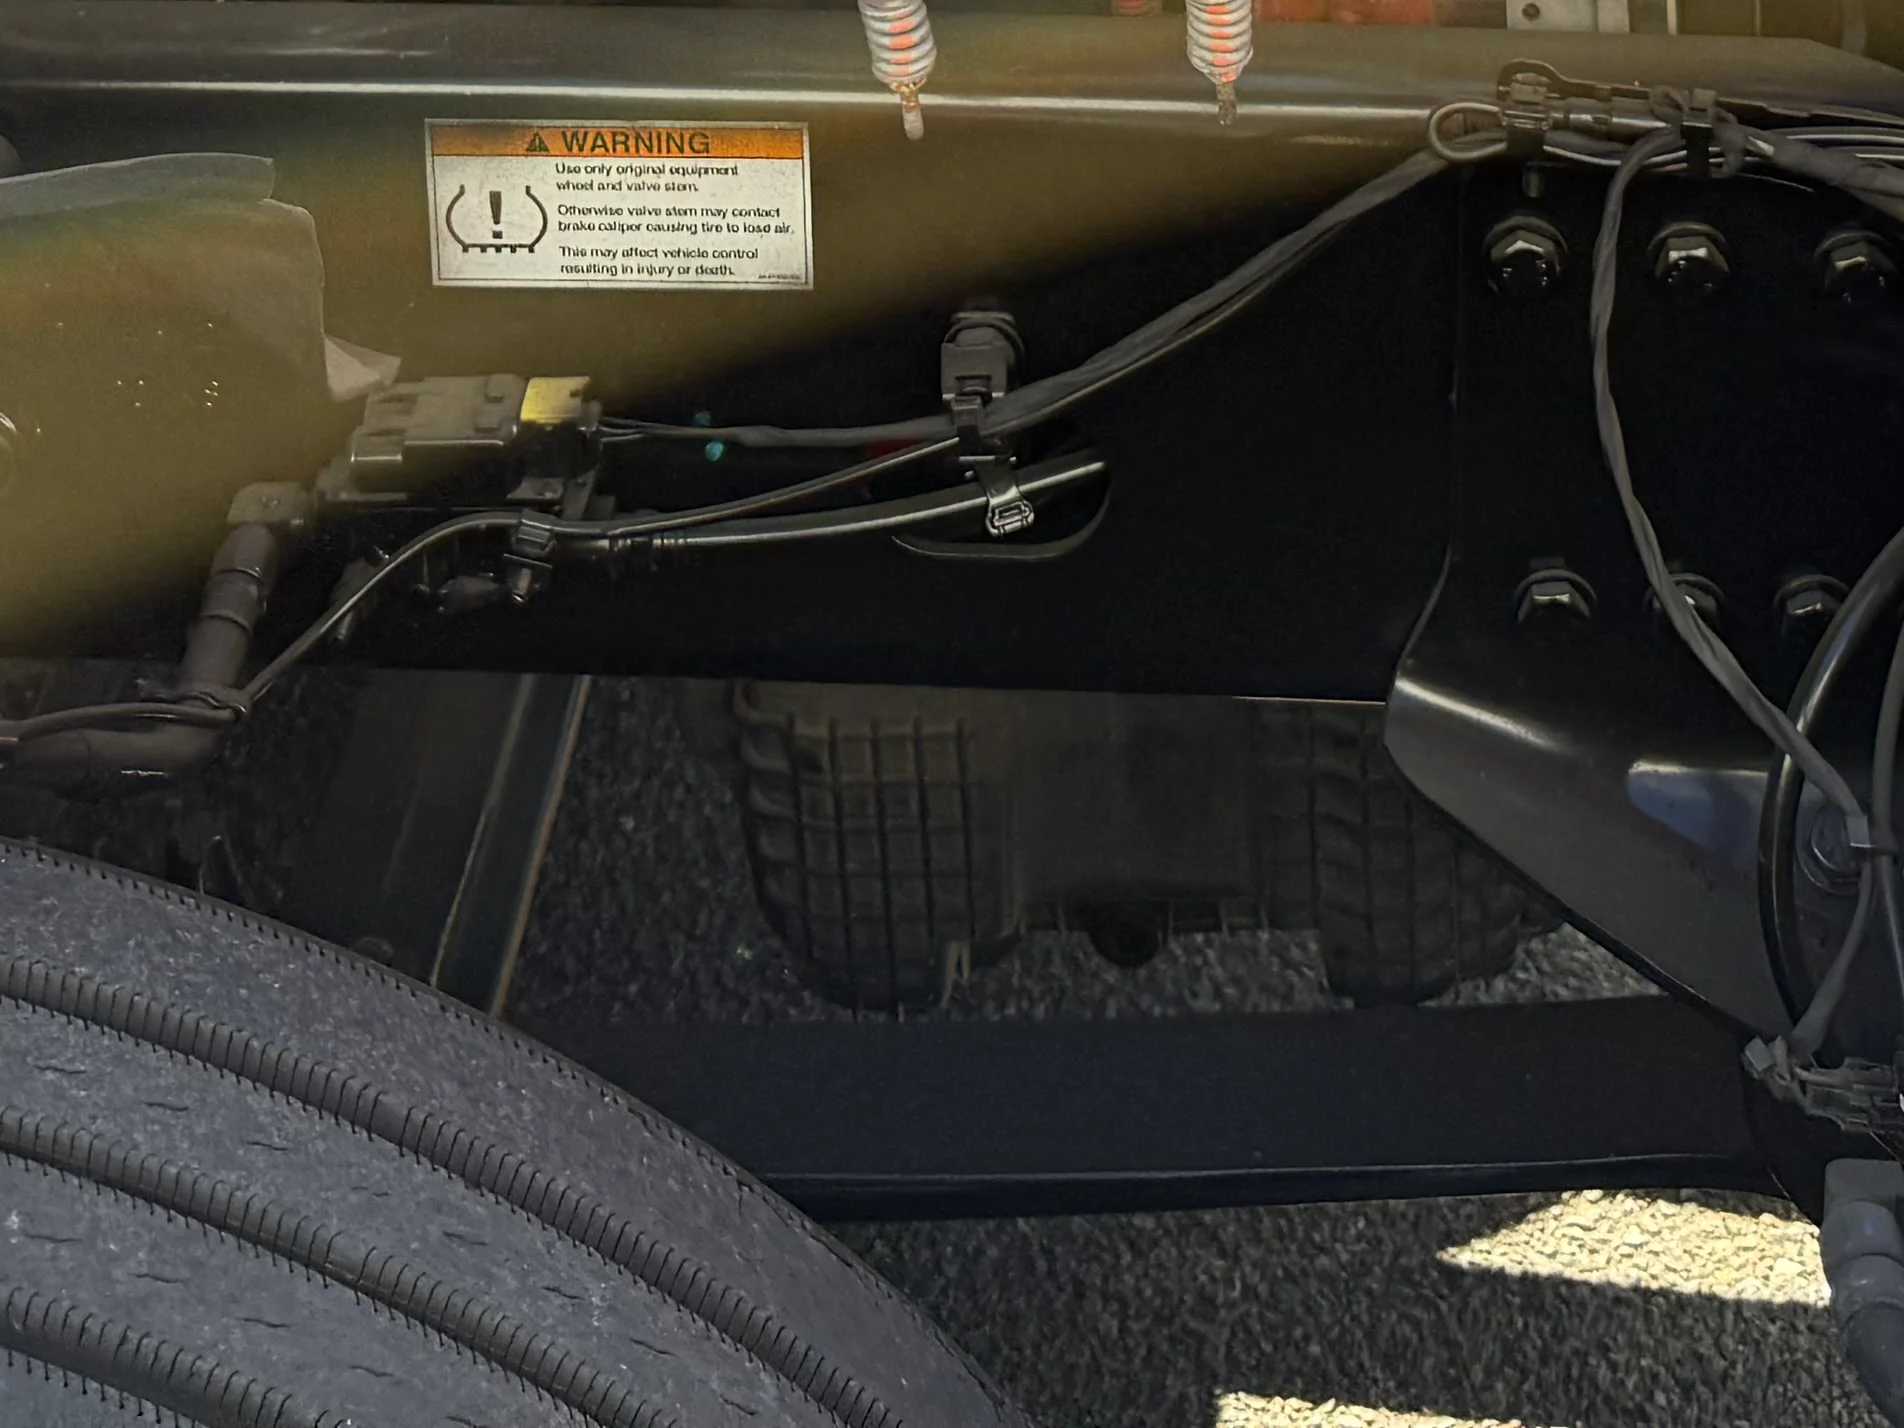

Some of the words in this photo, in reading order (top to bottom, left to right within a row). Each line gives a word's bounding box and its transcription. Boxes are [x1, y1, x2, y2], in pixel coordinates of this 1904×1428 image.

[561, 130, 711, 155] WARNING
[555, 161, 581, 175] Use
[584, 163, 612, 177] only
[615, 163, 666, 177] original
[669, 165, 739, 179] equipment
[556, 180, 594, 191] wheel
[597, 180, 622, 191] and
[626, 180, 661, 191] valve
[664, 181, 699, 192] stem.
[557, 204, 624, 216] Otherwise
[627, 205, 662, 216] valve
[665, 206, 697, 217] stem
[700, 207, 728, 219] may
[731, 206, 780, 218] contact
[558, 220, 595, 232] brake
[598, 221, 642, 234] caliper
[645, 222, 697, 235] causing
[701, 221, 723, 233] tire
[726, 222, 739, 233] to
[743, 222, 771, 233] lose
[774, 222, 795, 235] air.
[559, 246, 587, 257] This
[590, 247, 618, 260] may
[621, 247, 658, 258] affect
[661, 247, 709, 259] vehicle
[712, 248, 759, 259] control
[560, 263, 618, 276] resulting
[621, 263, 633, 275] in
[636, 263, 674, 278] injury
[677, 265, 691, 275] or
[695, 264, 736, 276] death.
